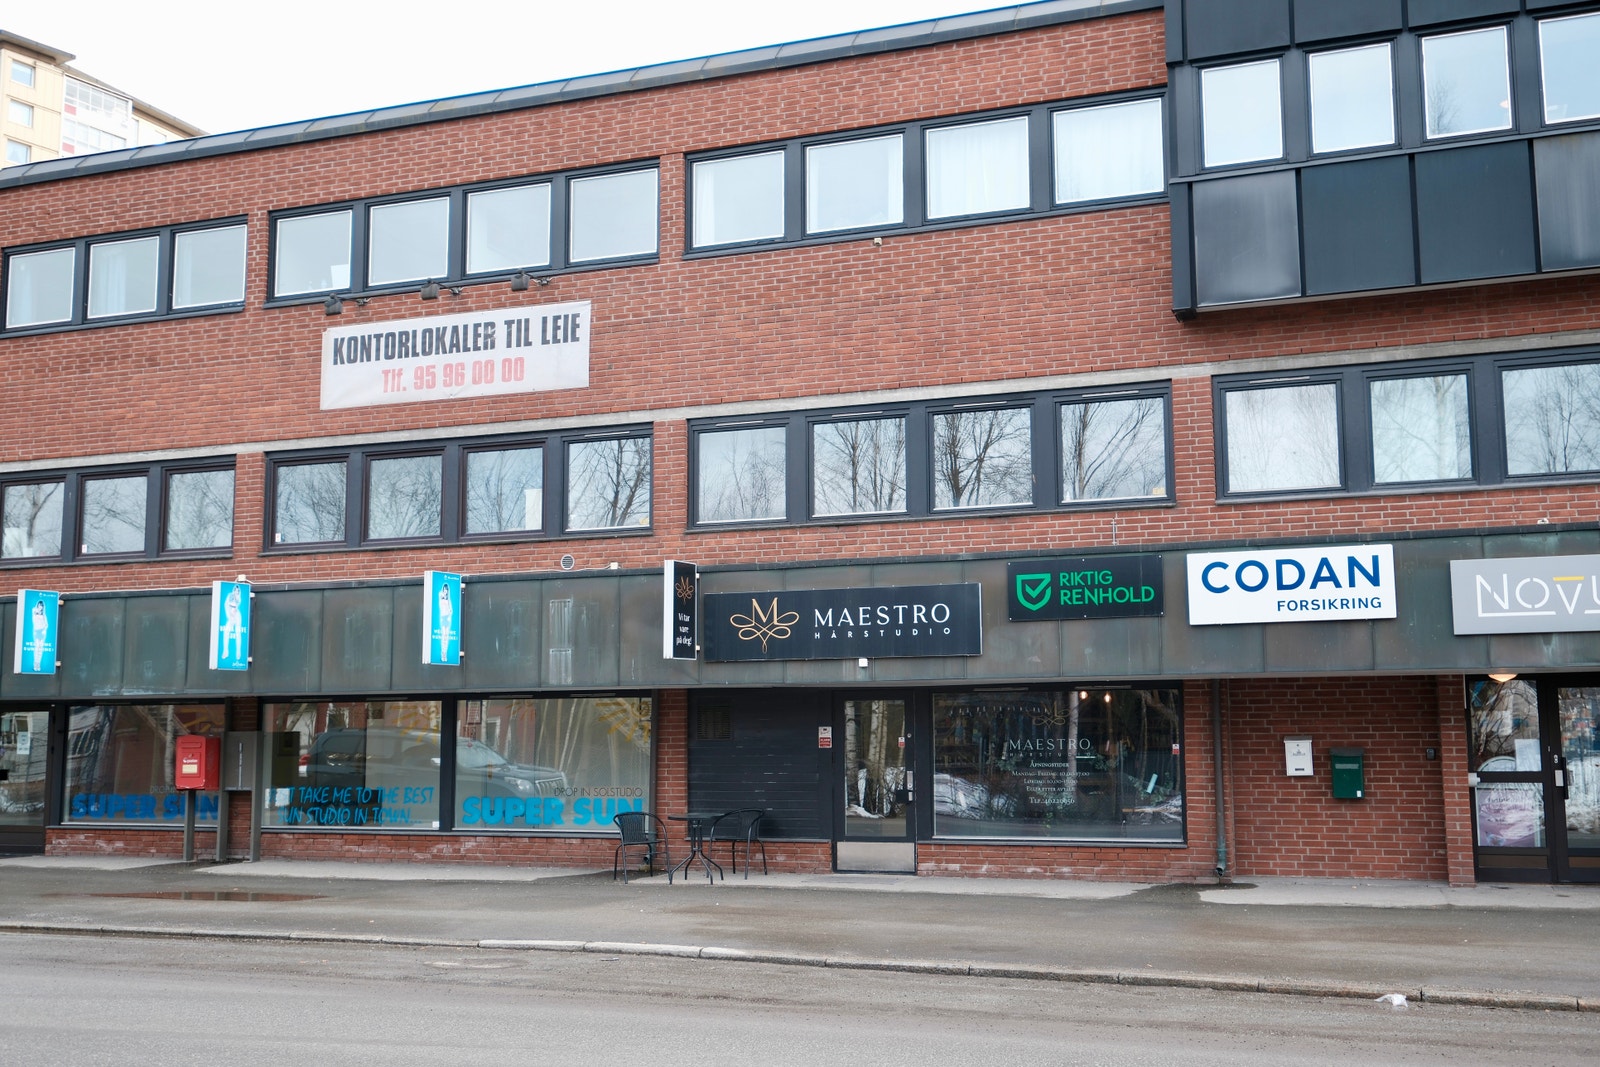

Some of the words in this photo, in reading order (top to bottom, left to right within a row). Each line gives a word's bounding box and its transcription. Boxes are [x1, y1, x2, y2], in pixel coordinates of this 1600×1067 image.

[333, 321, 496, 366] KONTORLOKALER
[504, 317, 533, 348] TIL
[541, 312, 580, 345] LEIE
[382, 367, 407, 393] Tlf.
[413, 364, 437, 391] 95
[442, 362, 466, 388] 96
[471, 359, 495, 385] 00
[501, 356, 525, 383] 00
[1059, 570, 1113, 586] RIKTIG
[1201, 554, 1381, 594] CODAN
[1060, 585, 1155, 606] RENHOLD
[1277, 597, 1382, 612] FORSIKRING
[678, 613, 684, 621] Vi
[814, 603, 950, 628] MAESTRO
[814, 627, 950, 640] HÅRSTUDIO
[1009, 738, 1091, 751] MAESTRO
[299, 786, 331, 804] TAKE
[332, 786, 352, 804] ME
[355, 786, 372, 804] TO
[376, 786, 401, 804] THE
[403, 786, 435, 804] BEST
[554, 787, 578, 797] DROP
[580, 787, 591, 797] IN
[593, 787, 643, 797] SOLSTUDIO
[71, 793, 157, 819] SUPER
[162, 794, 220, 821] SUN
[277, 806, 303, 825] SUN
[305, 807, 351, 825] STUDIO
[353, 807, 369, 824] IN
[462, 796, 565, 825] SUPER
[572, 796, 643, 827] SUN
